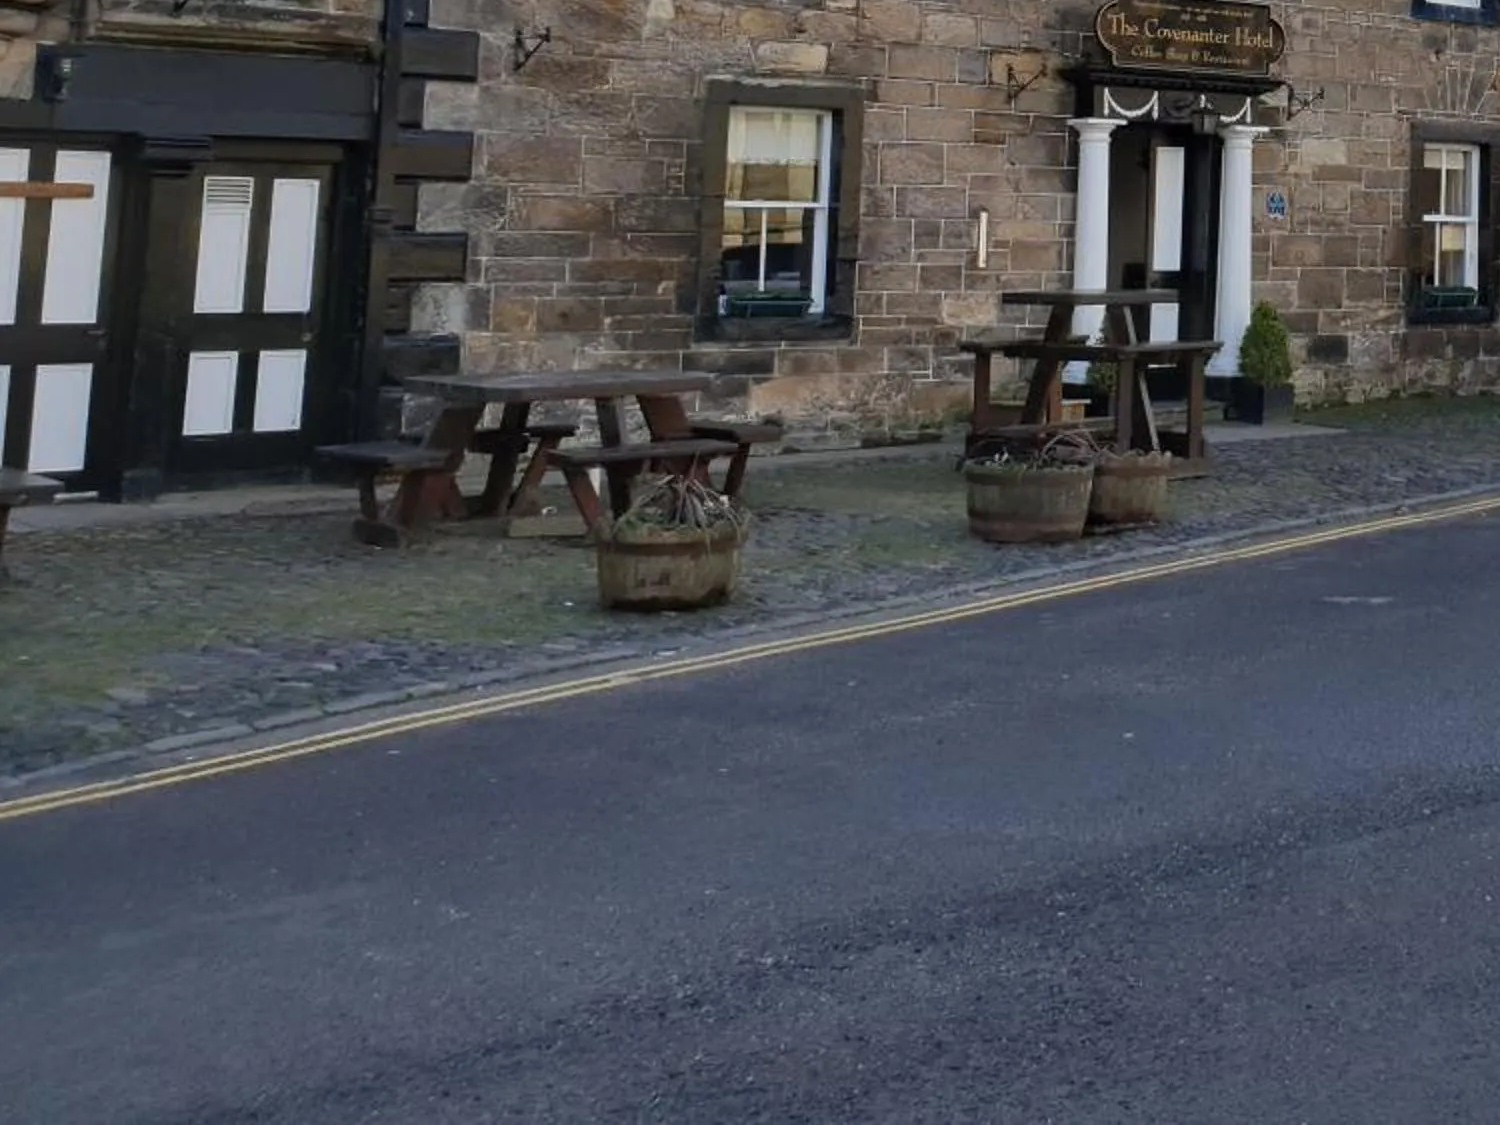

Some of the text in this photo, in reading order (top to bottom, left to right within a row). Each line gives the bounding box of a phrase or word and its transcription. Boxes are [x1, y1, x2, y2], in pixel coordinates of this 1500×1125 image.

[1107, 12, 1273, 49] The Covenanter Hotel
